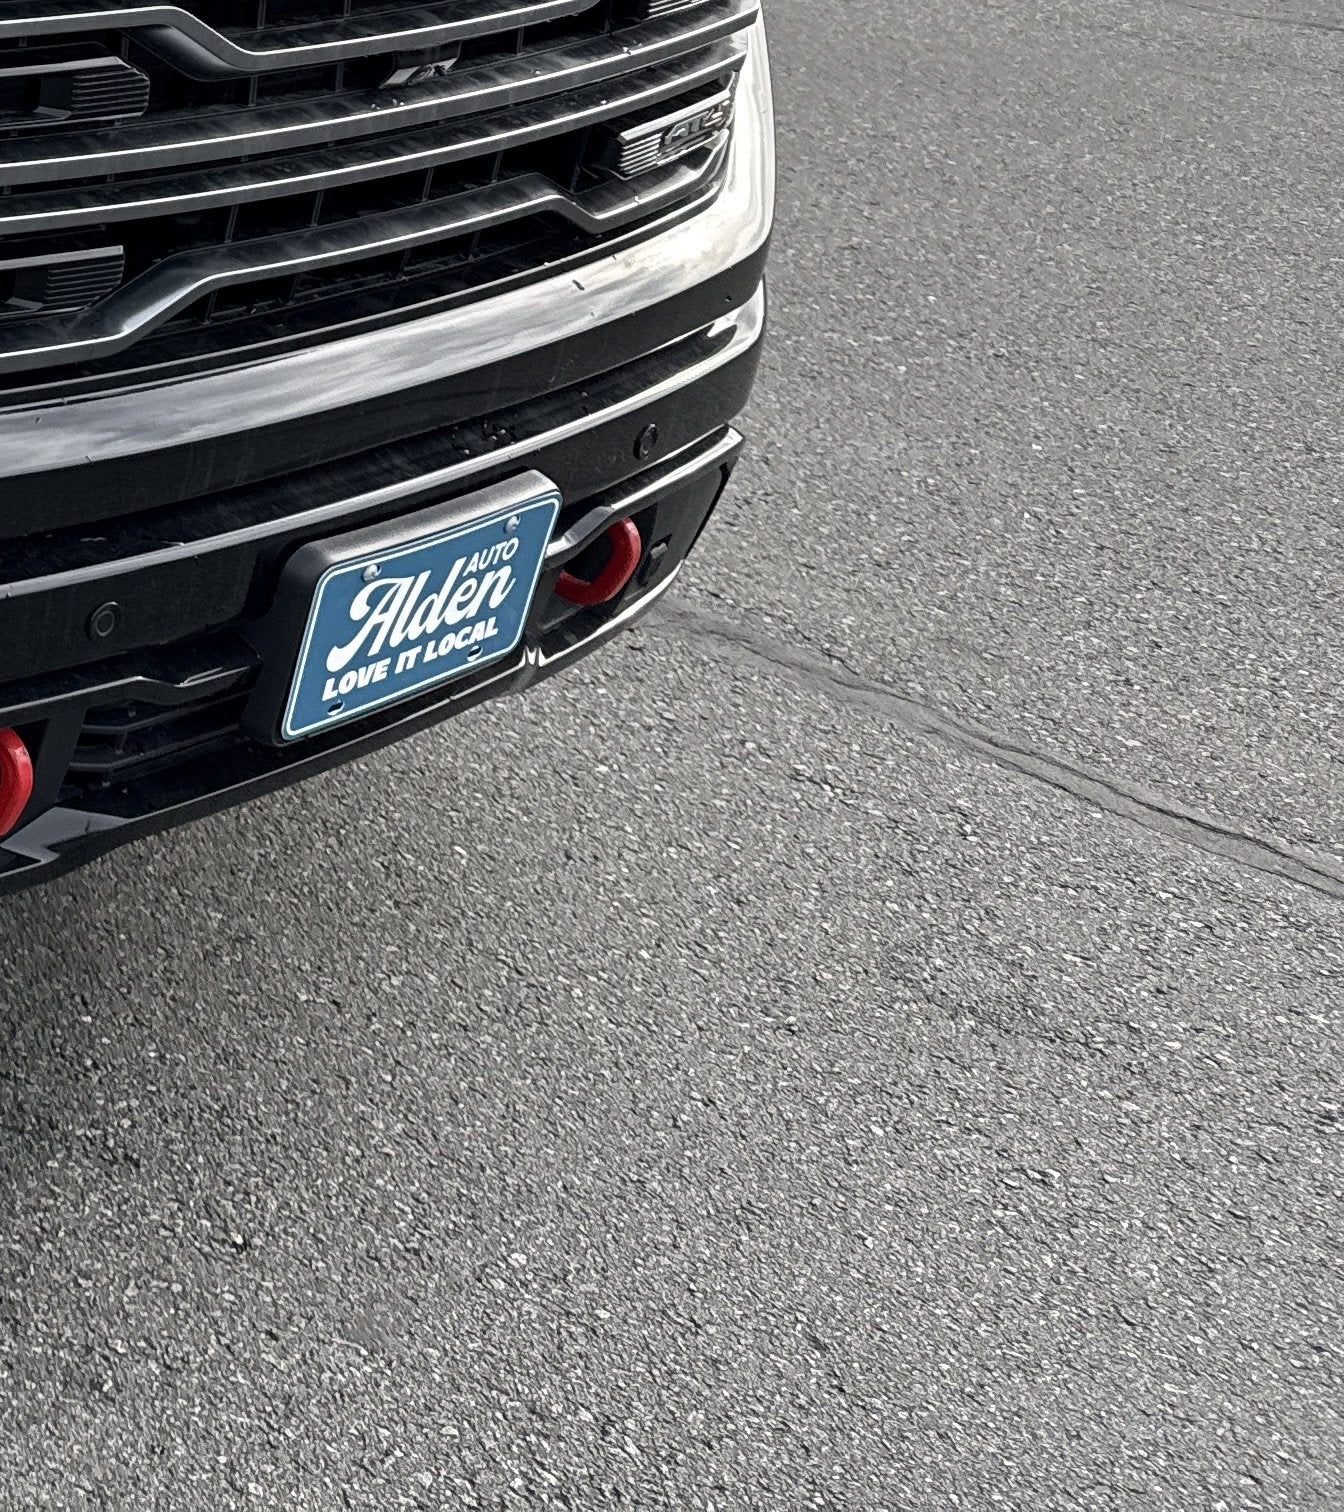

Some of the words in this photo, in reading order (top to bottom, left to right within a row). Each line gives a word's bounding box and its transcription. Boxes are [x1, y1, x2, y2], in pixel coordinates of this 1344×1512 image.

[463, 536, 520, 573] AUTO
[325, 558, 517, 673] Alden
[322, 663, 390, 702] LOVE
[395, 645, 423, 674] IT
[424, 616, 499, 663] LOCAL
